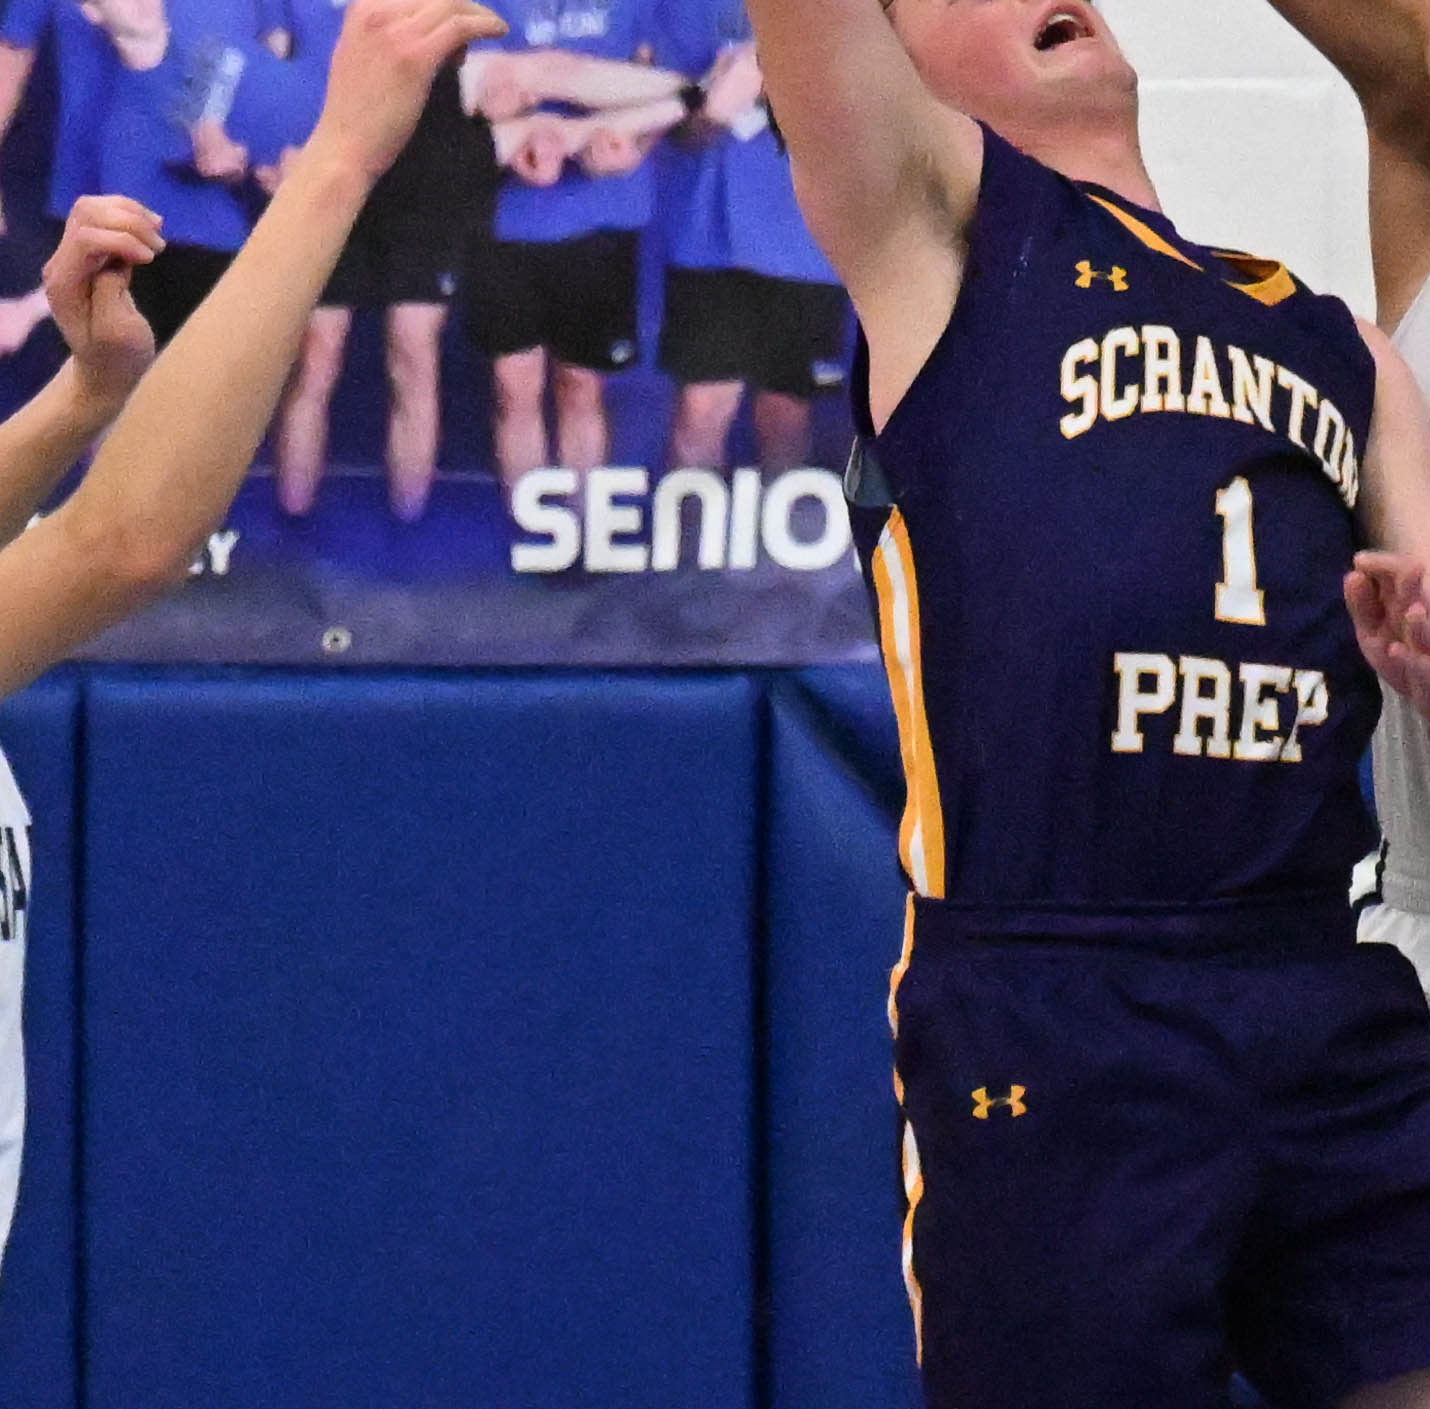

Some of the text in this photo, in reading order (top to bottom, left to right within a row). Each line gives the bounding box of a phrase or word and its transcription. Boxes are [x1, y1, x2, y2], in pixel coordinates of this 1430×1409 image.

[510, 467, 862, 573] SENIO
[1214, 475, 1266, 626] 1
[1111, 652, 1330, 762] PREP
